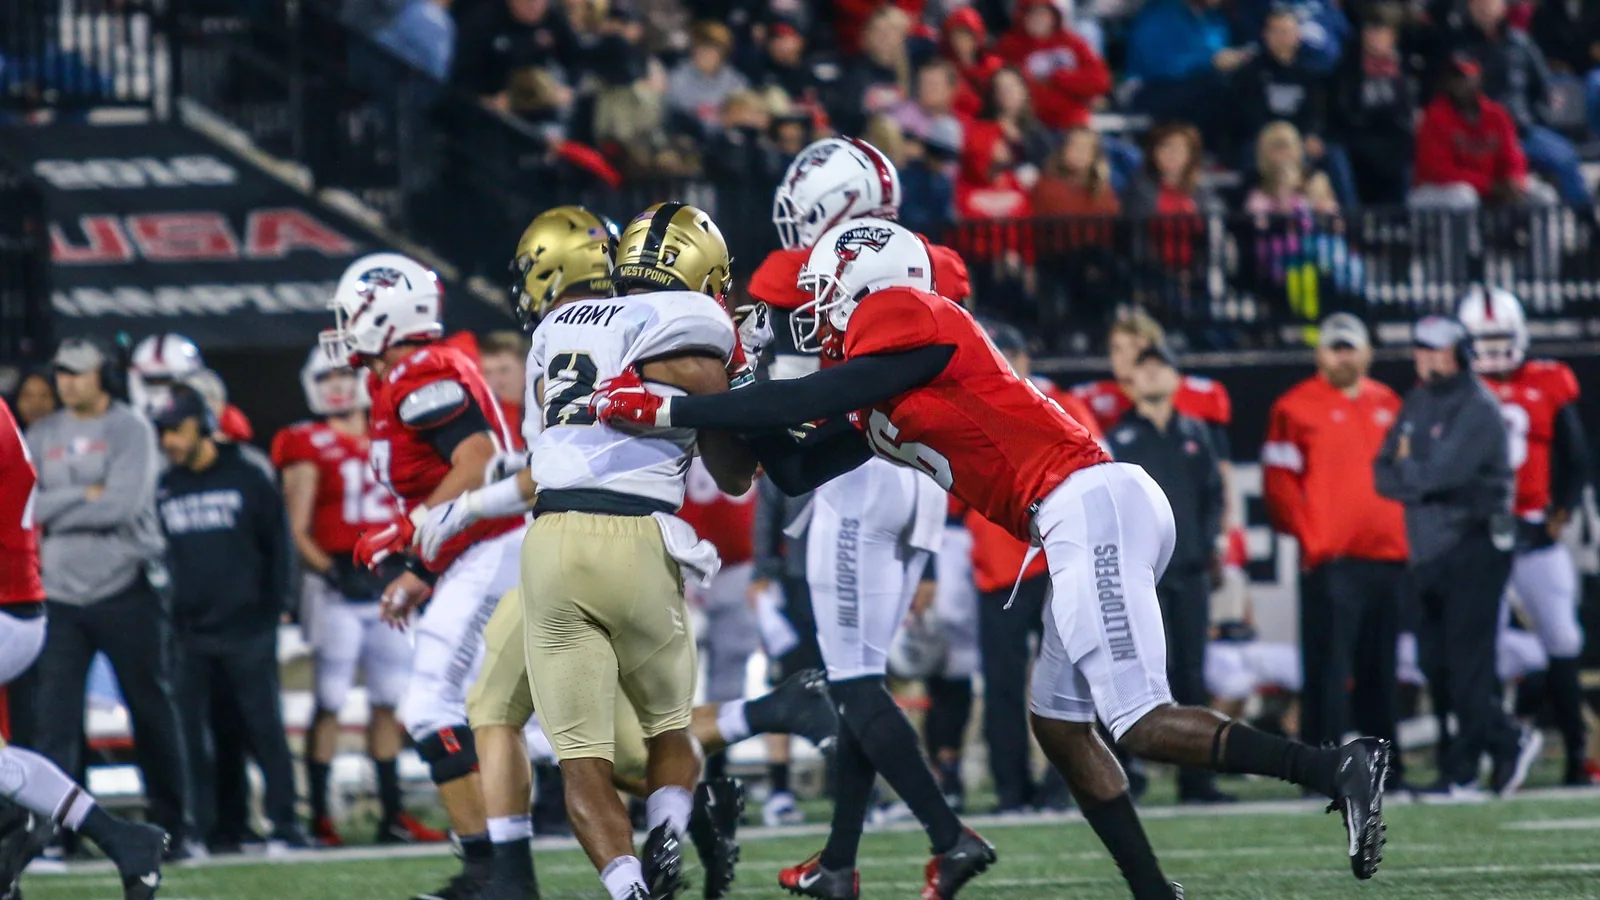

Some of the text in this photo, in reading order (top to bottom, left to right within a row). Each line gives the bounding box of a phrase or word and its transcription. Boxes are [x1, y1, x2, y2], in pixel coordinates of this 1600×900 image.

[49, 208, 354, 262] USA
[852, 230, 881, 240] WKU
[620, 266, 675, 287] WEST POINT
[554, 305, 625, 327] ARMY
[836, 518, 860, 628] HILLTOPPERS
[1094, 543, 1137, 661] HILLTOPPERS
